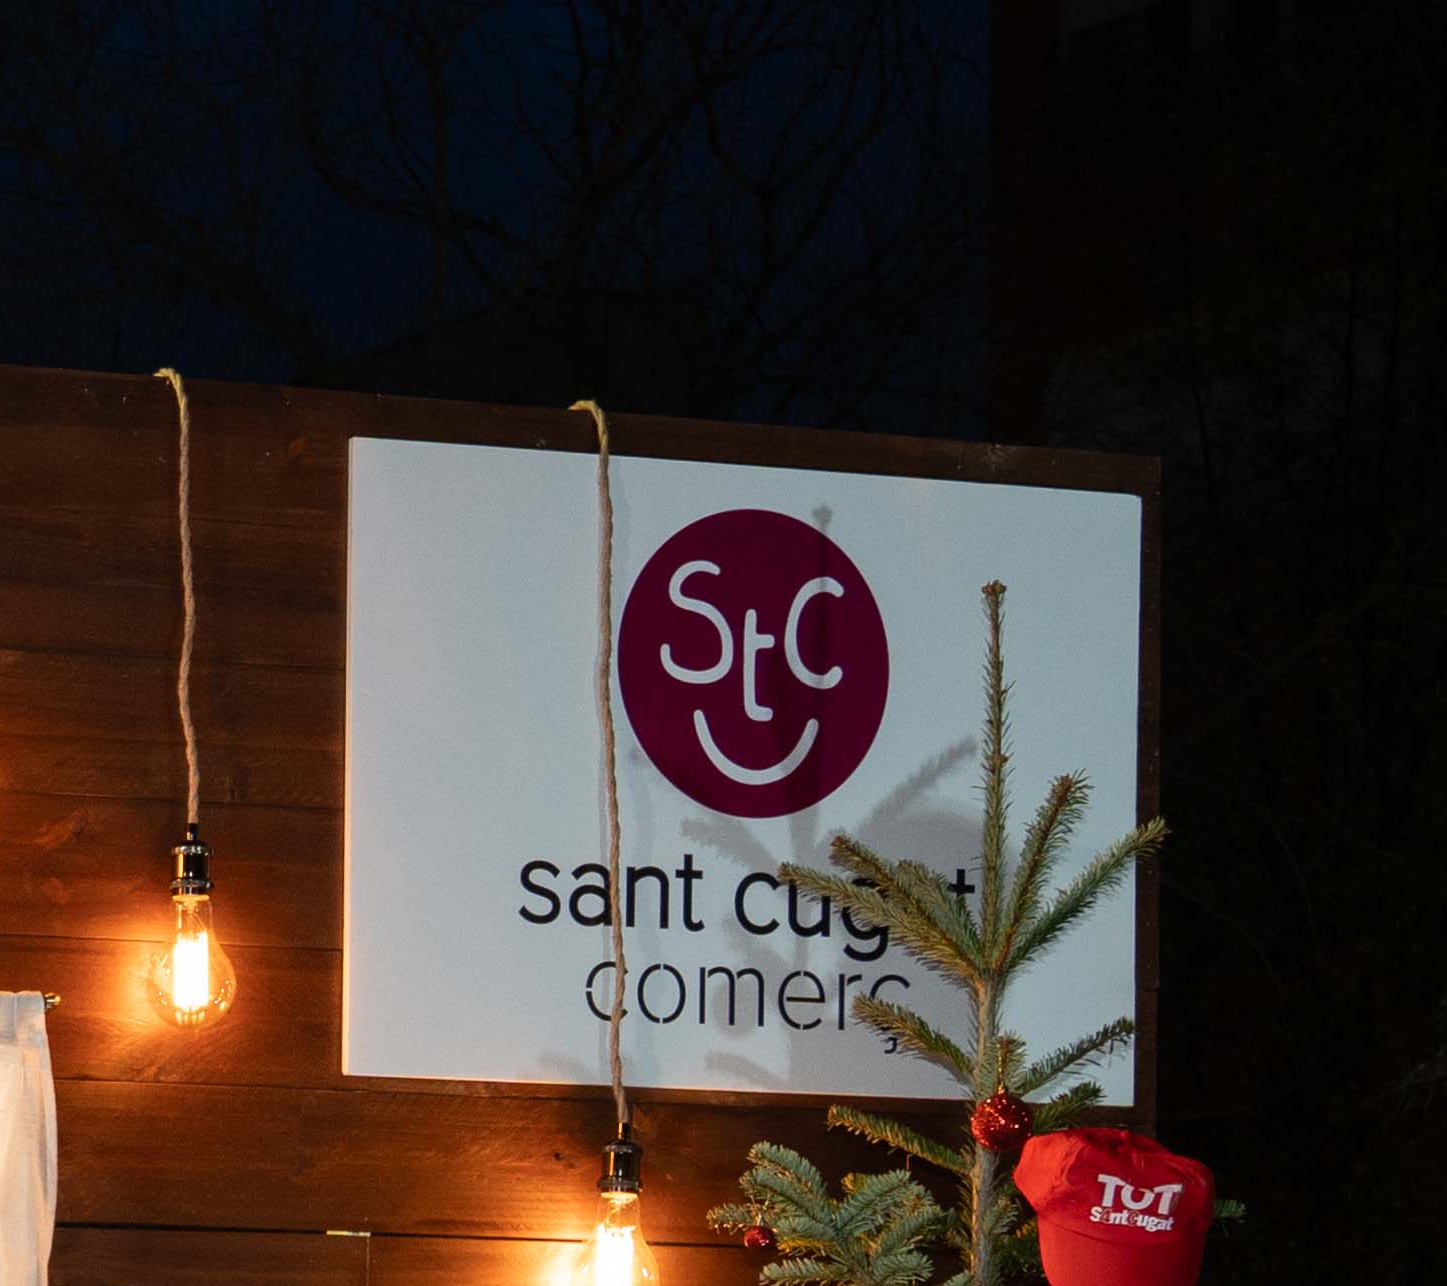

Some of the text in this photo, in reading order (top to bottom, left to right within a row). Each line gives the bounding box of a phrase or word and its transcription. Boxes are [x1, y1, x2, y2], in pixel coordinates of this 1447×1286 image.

[660, 560, 844, 722] StC
[518, 854, 975, 962] sant cug
[1098, 1173, 1182, 1215] TOT
